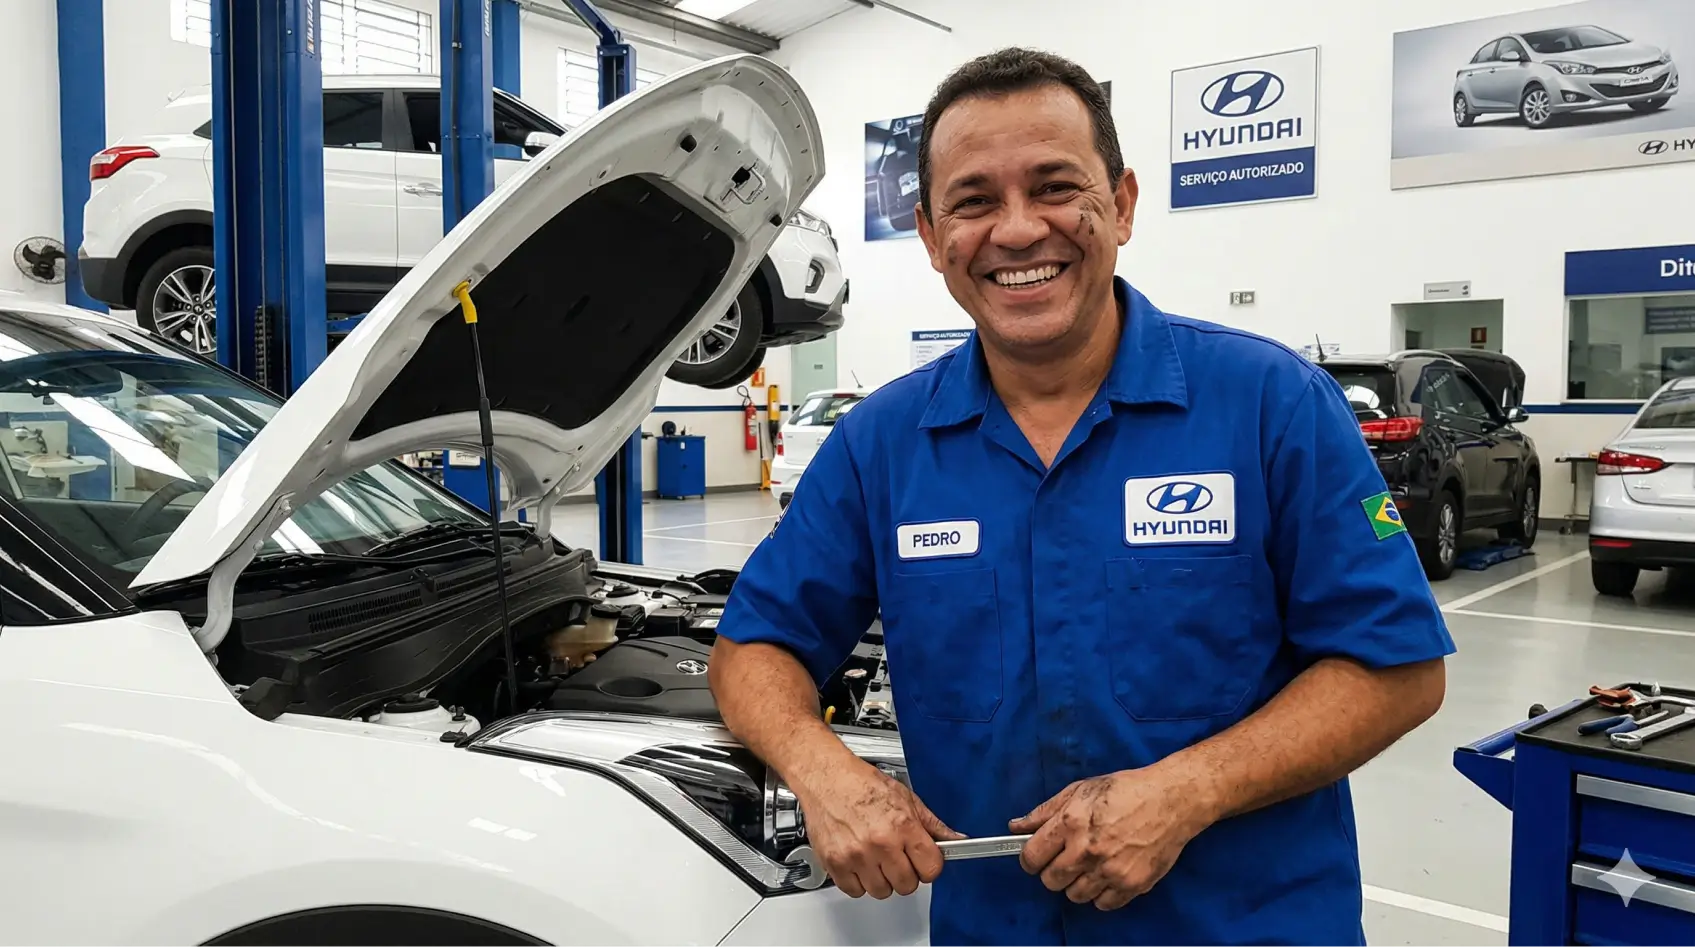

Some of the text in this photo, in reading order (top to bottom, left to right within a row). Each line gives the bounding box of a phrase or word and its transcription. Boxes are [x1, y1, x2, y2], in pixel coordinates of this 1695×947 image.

[1183, 117, 1302, 151] HYUNDAI
[1674, 138, 1695, 151] HY
[1180, 161, 1304, 186] SERVIÇO AUTORIZADO
[1660, 257, 1695, 277] Dit
[1133, 520, 1227, 536] HYUNDAI
[912, 530, 961, 548] PEDRO
